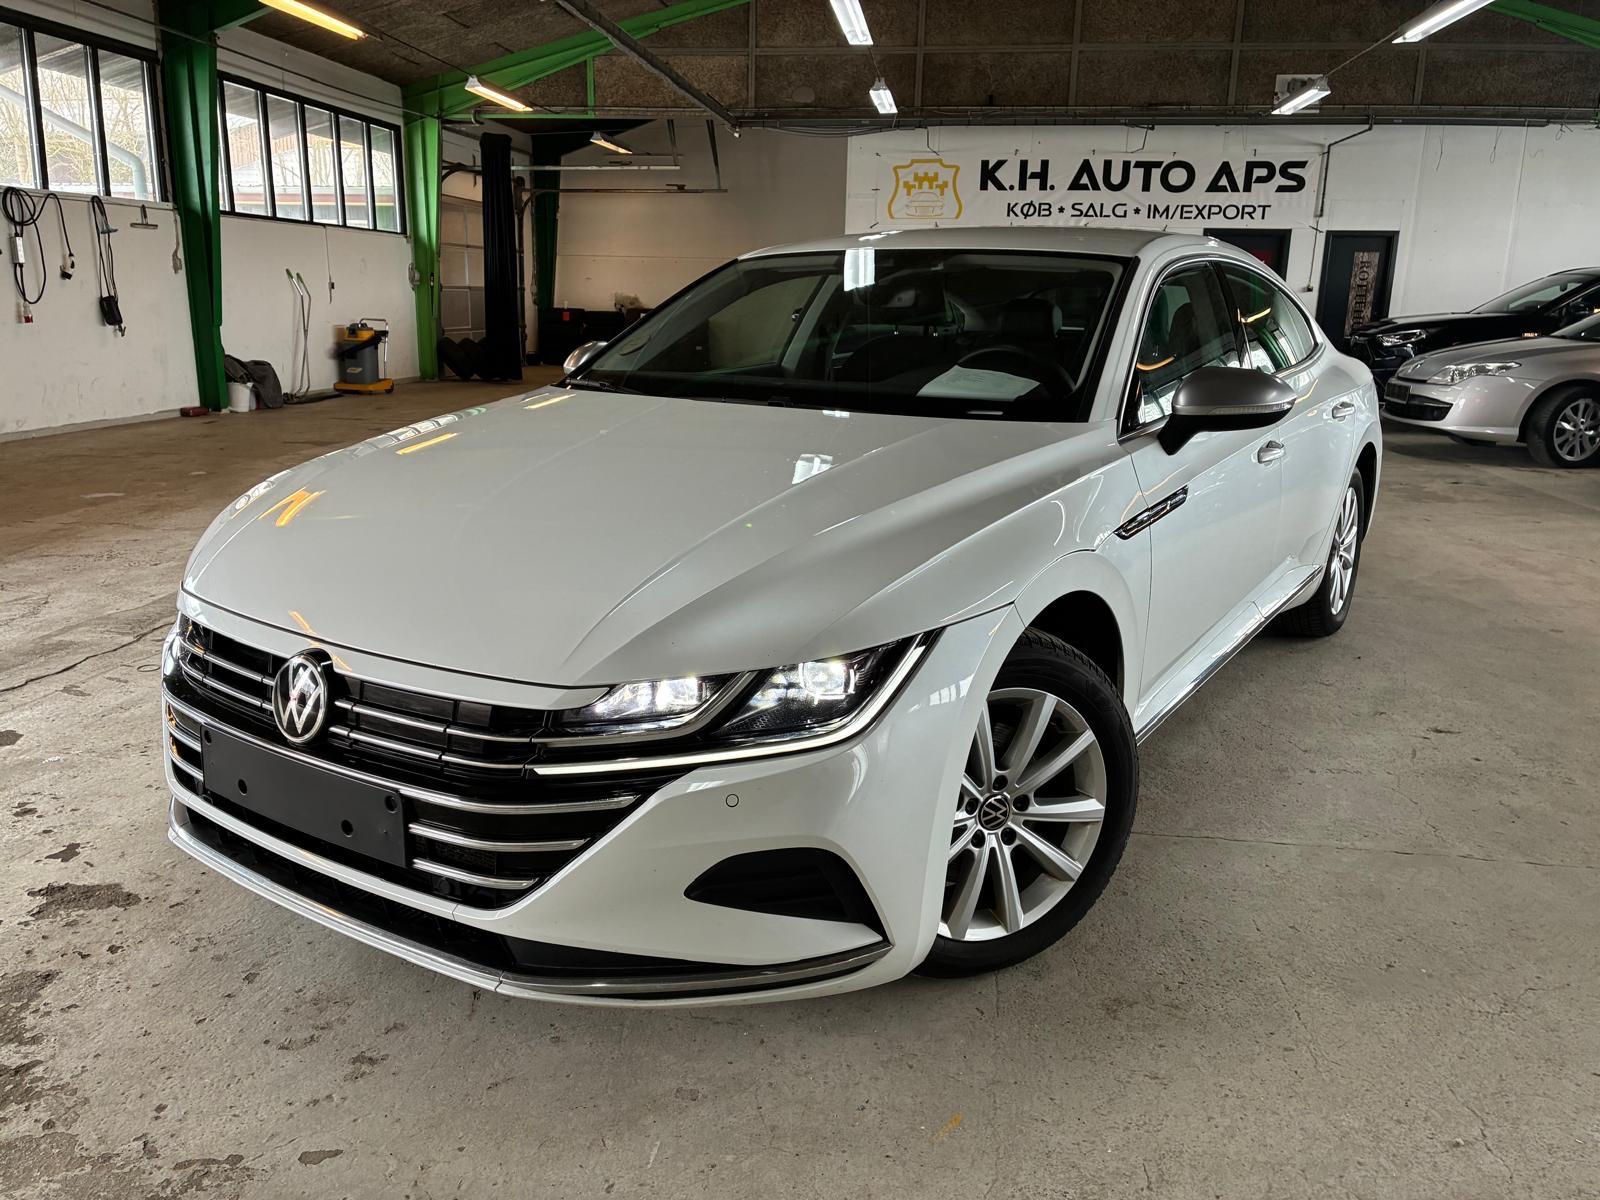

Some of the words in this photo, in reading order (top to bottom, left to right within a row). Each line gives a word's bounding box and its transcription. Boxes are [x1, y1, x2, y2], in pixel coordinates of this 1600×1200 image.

[980, 158, 1056, 192] K.H.
[1066, 158, 1196, 194] AUTO
[1204, 160, 1309, 193] APS
[1006, 200, 1053, 220] KØB
[1070, 202, 1128, 219] SALG
[1146, 203, 1272, 221] IM/EXPORT
